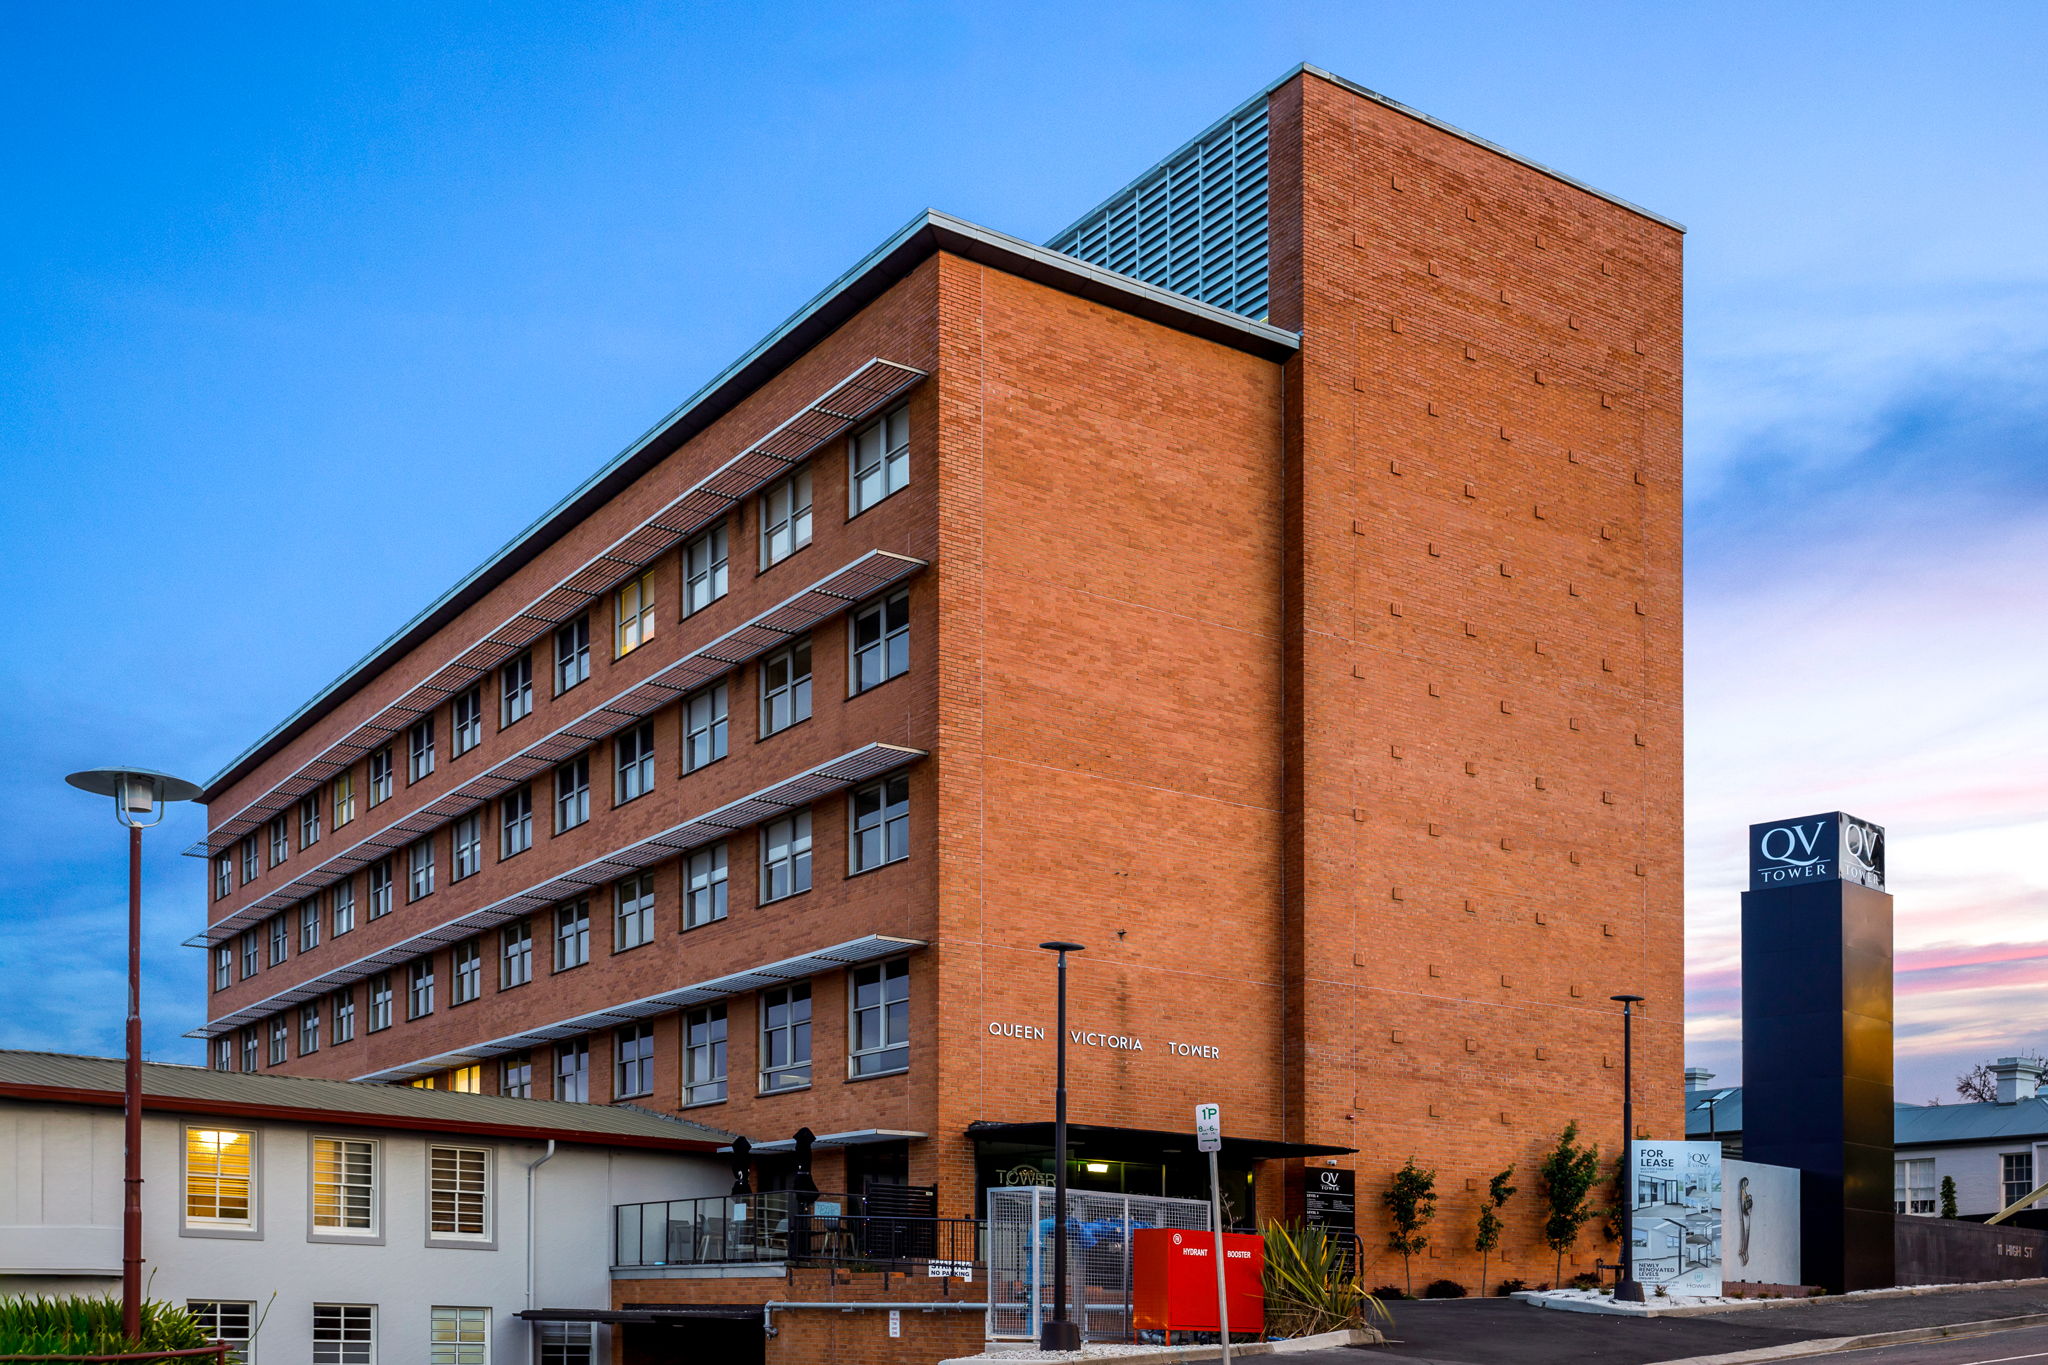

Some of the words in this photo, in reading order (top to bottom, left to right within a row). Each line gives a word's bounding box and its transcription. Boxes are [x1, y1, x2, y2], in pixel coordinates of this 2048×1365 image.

[1761, 821, 1826, 866] QV
[1845, 824, 1878, 871] QV
[1761, 864, 1826, 883] TOWER
[1845, 864, 1879, 885] TOWER
[988, 1021, 1045, 1041] QUEEN
[1070, 1030, 1143, 1051] VICTORIA
[1168, 1041, 1220, 1060] TOWER
[1202, 1108, 1217, 1120] 1P
[1640, 1149, 1664, 1158] FOR
[1692, 1153, 1710, 1165] QV
[1640, 1158, 1674, 1168] LEASE
[995, 1169, 1057, 1187] TOWER
[1321, 1172, 1339, 1186] QV
[1183, 1247, 1208, 1257] HYDRANT
[1227, 1250, 1252, 1259] BOOSTER
[2006, 1244, 2022, 1257] HIGH
[2024, 1247, 2033, 1258] ST
